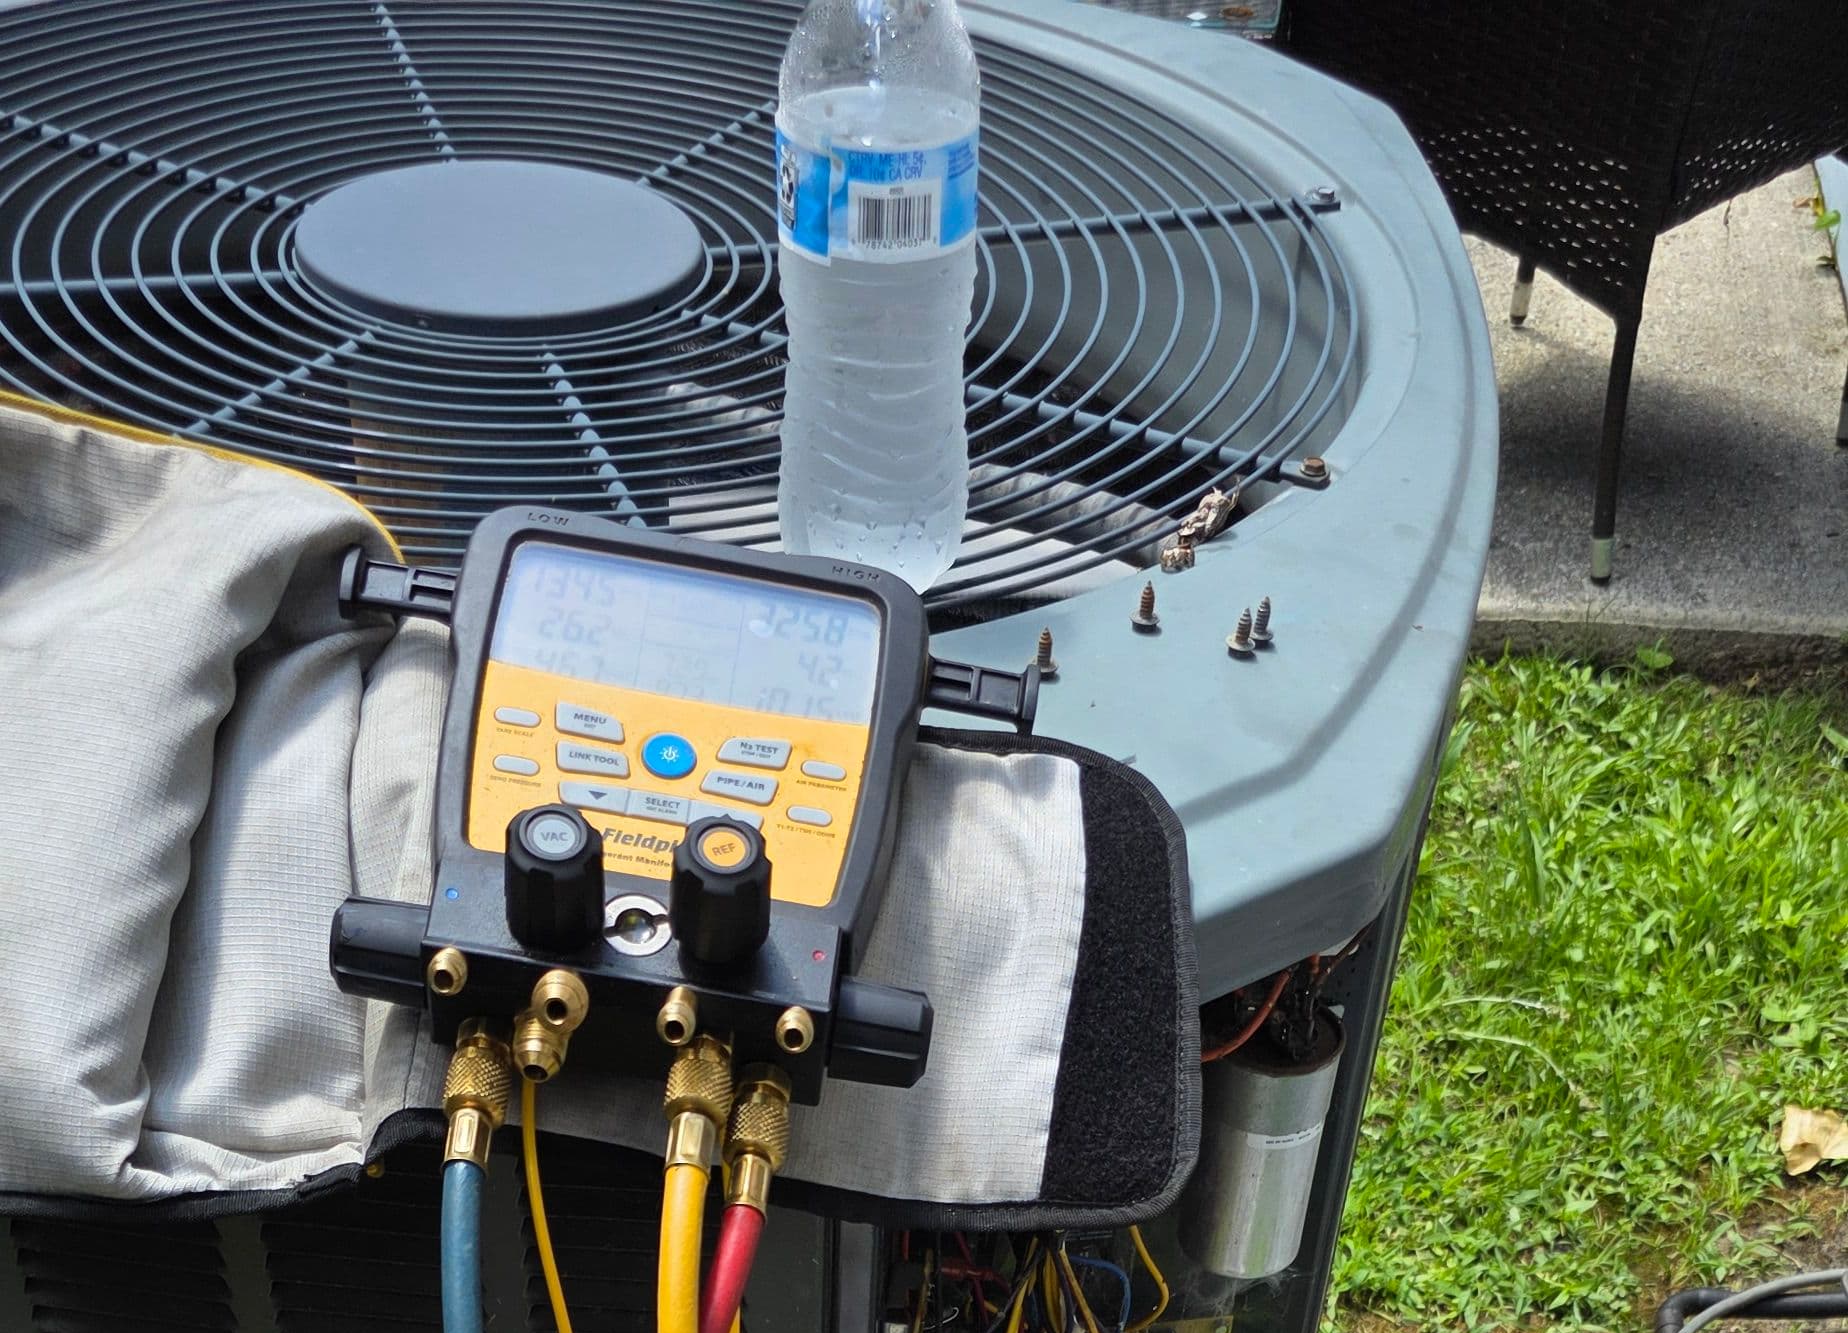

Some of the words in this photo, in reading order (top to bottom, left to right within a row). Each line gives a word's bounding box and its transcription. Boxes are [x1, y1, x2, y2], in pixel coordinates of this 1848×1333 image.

[526, 510, 569, 528] LOW
[830, 564, 882, 583] HIGH
[573, 712, 607, 725] MENU
[754, 743, 778, 755] TEST
[568, 750, 592, 761] LINK
[593, 754, 620, 766] TOOL
[716, 775, 765, 792] PIPE/AIR
[644, 796, 680, 810] SELECT
[540, 832, 568, 841] VAC
[601, 826, 677, 856] Fieldpi
[711, 843, 735, 855] REF
